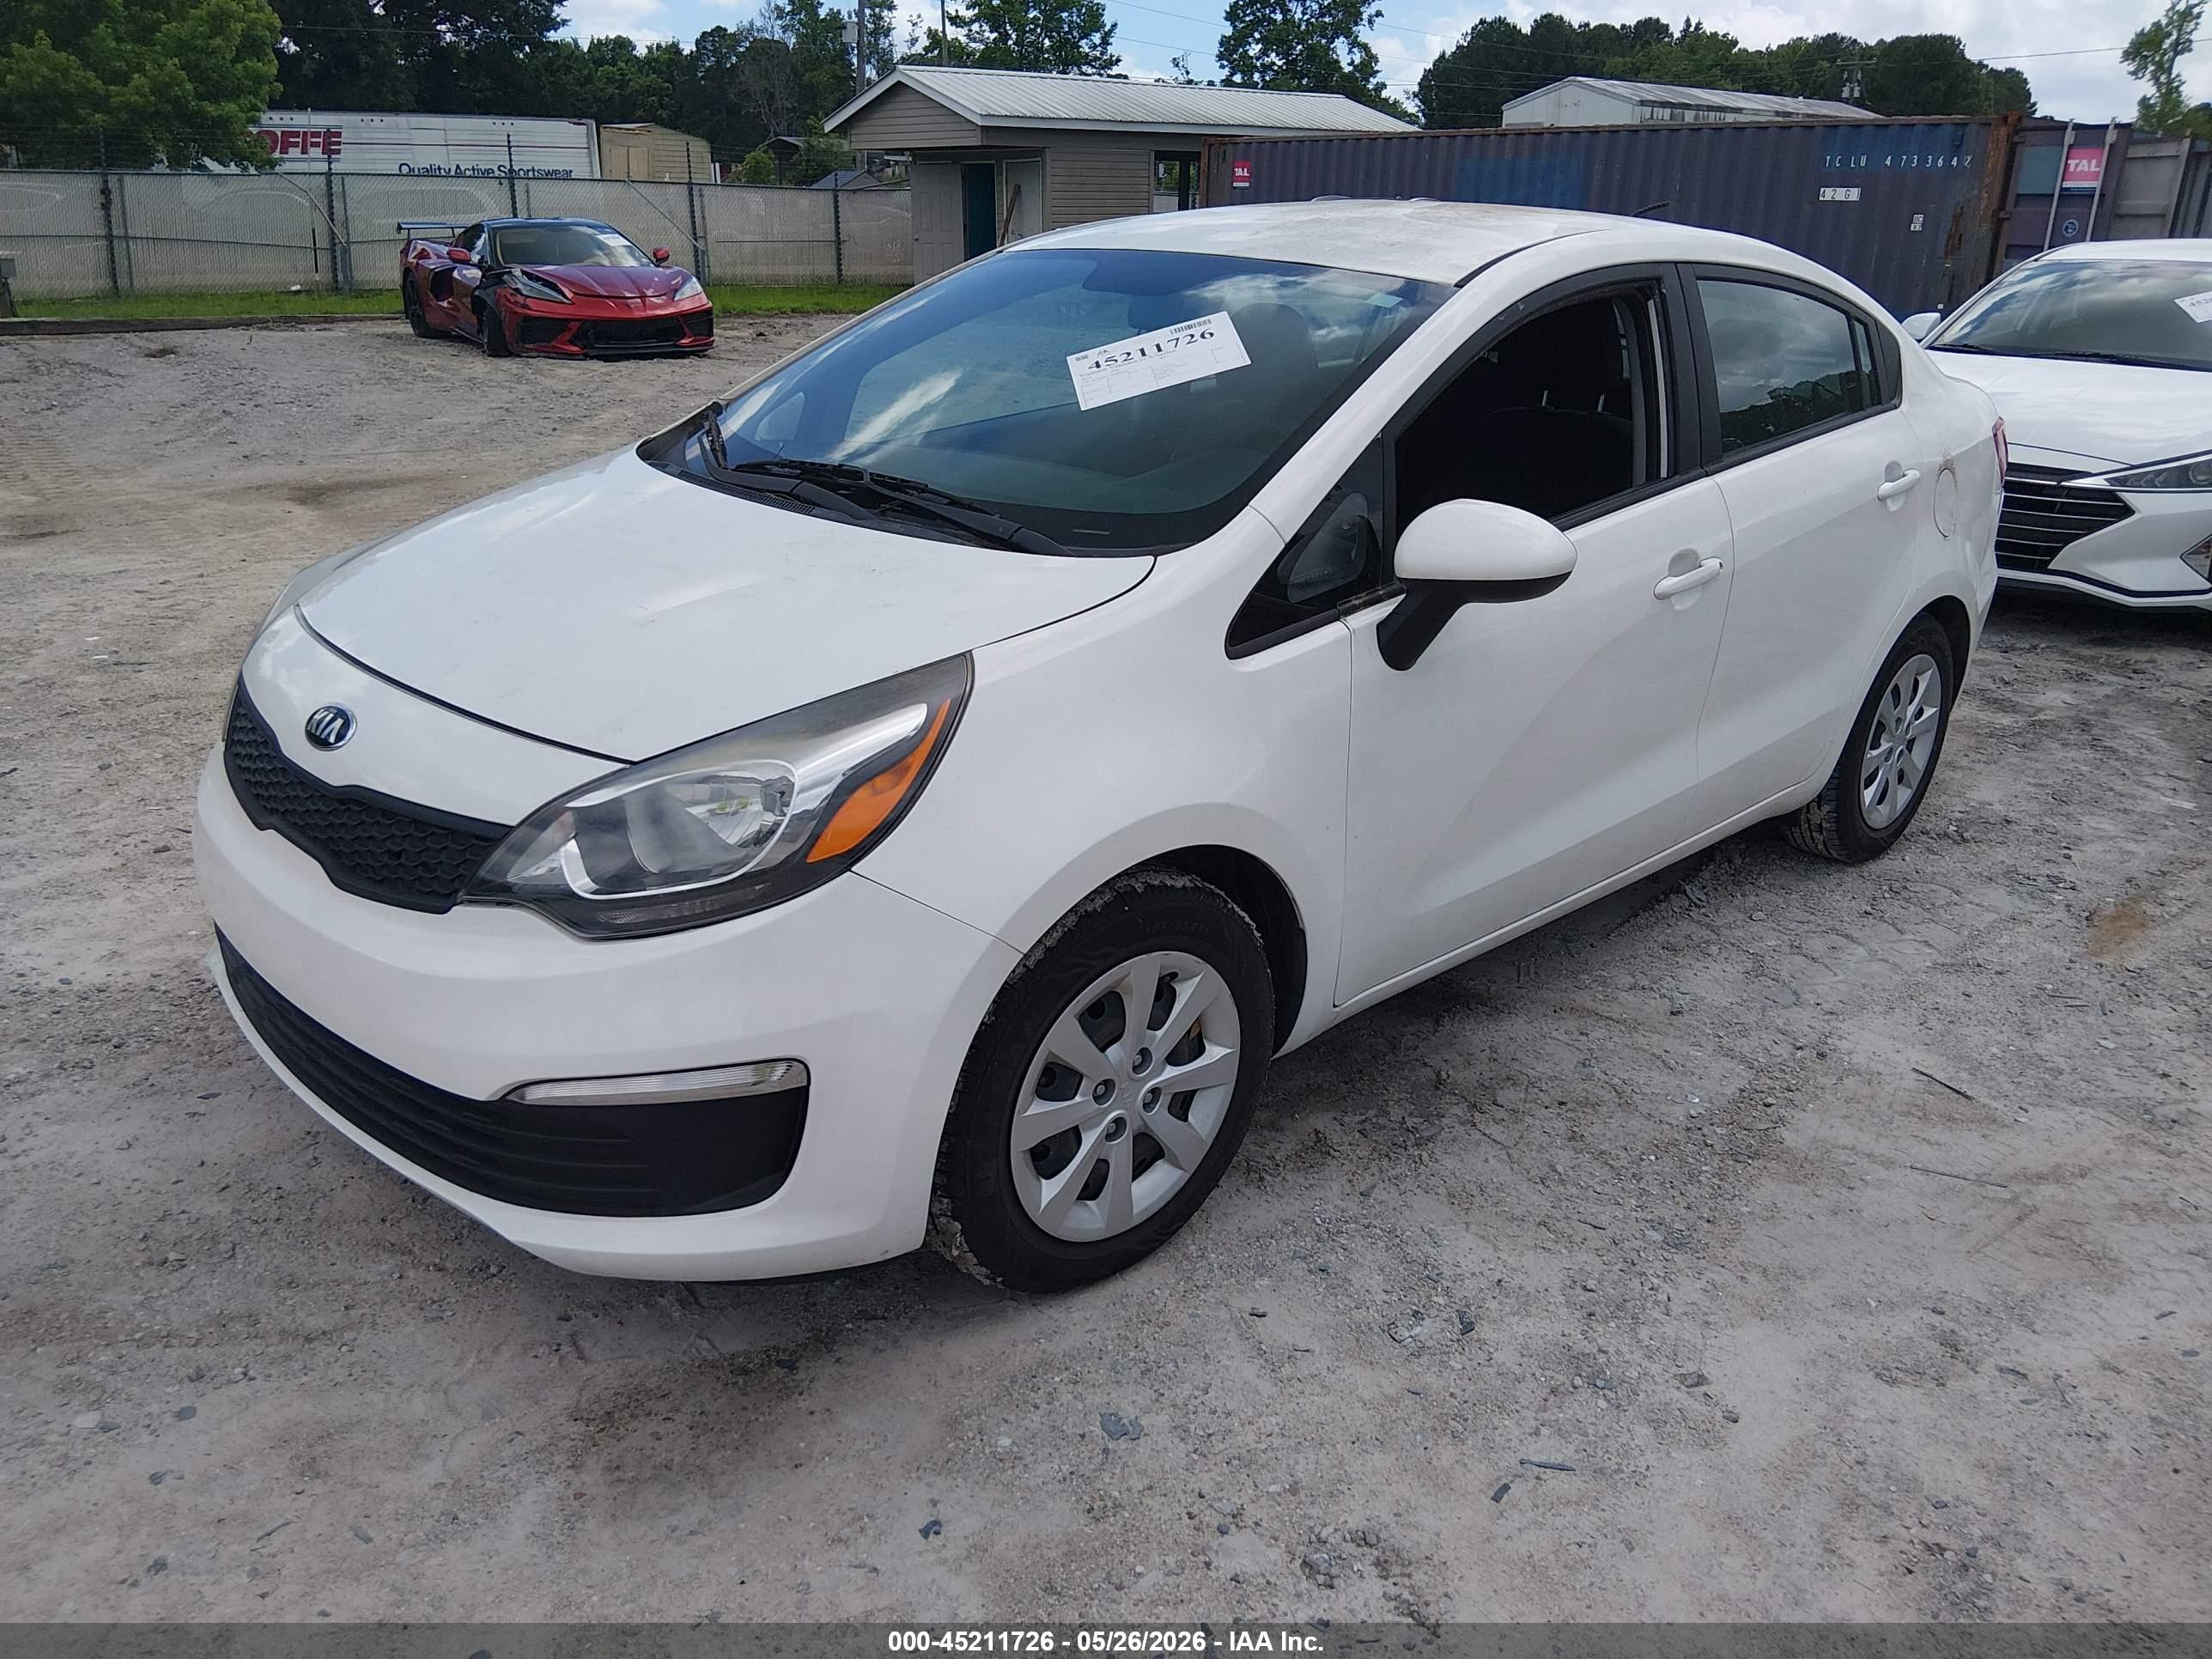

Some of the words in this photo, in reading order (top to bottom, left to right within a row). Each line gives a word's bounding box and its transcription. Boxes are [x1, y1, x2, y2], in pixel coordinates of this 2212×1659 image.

[247, 129, 343, 155] OFFE
[1826, 155, 1867, 167] TCLU
[2068, 160, 2100, 172] TAL
[398, 162, 452, 174] Quality
[454, 164, 495, 176] Active
[1234, 167, 1250, 177] TAL
[1088, 328, 1215, 369] 45211726
